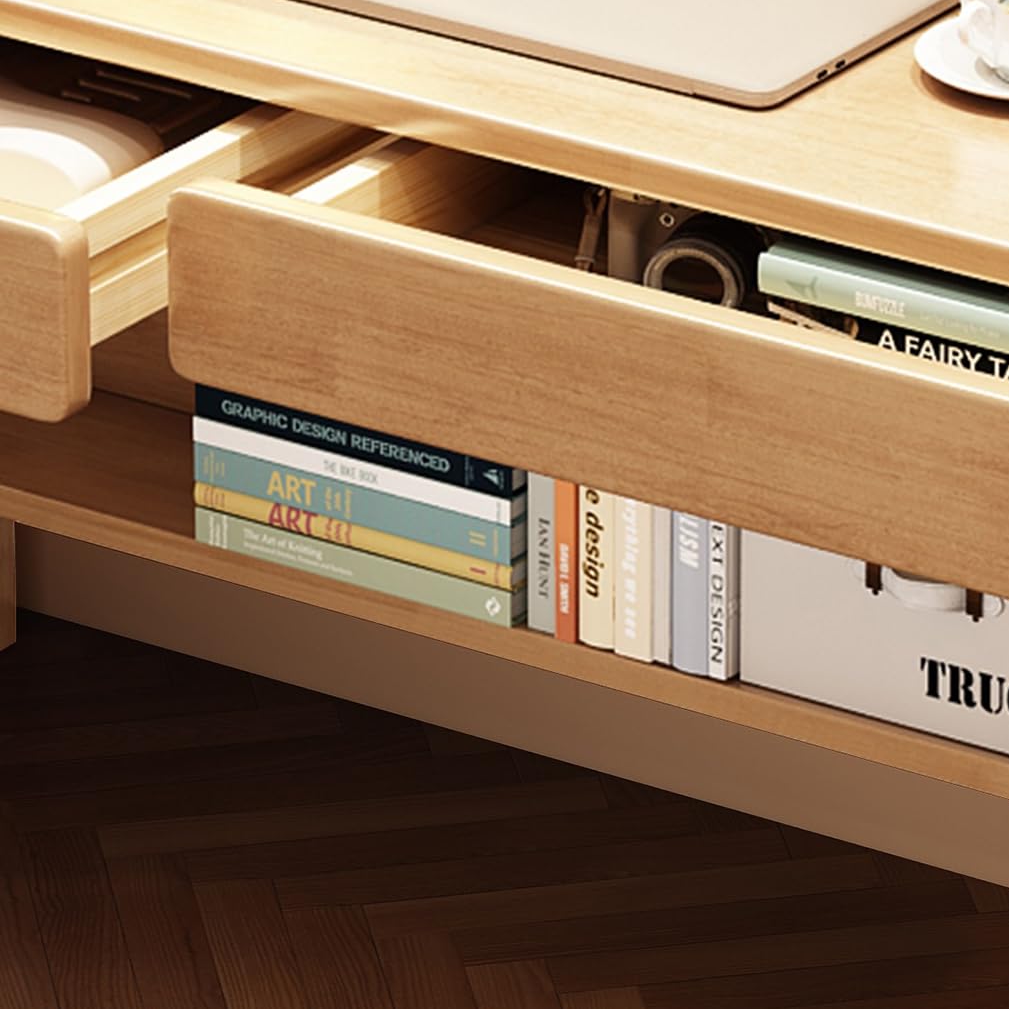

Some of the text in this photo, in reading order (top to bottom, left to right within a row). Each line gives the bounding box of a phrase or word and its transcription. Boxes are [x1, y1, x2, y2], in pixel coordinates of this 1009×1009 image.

[878, 329, 896, 351] A
[904, 335, 982, 374] FAIRY
[221, 399, 288, 430] GRAPHIC
[292, 418, 348, 448] DESIGN
[350, 433, 450, 474] REFERENCED
[267, 470, 317, 507] ART
[268, 502, 319, 536] ART
[538, 517, 551, 600] IAN HUNT
[582, 511, 605, 598] design
[710, 574, 725, 665] DESIGN
